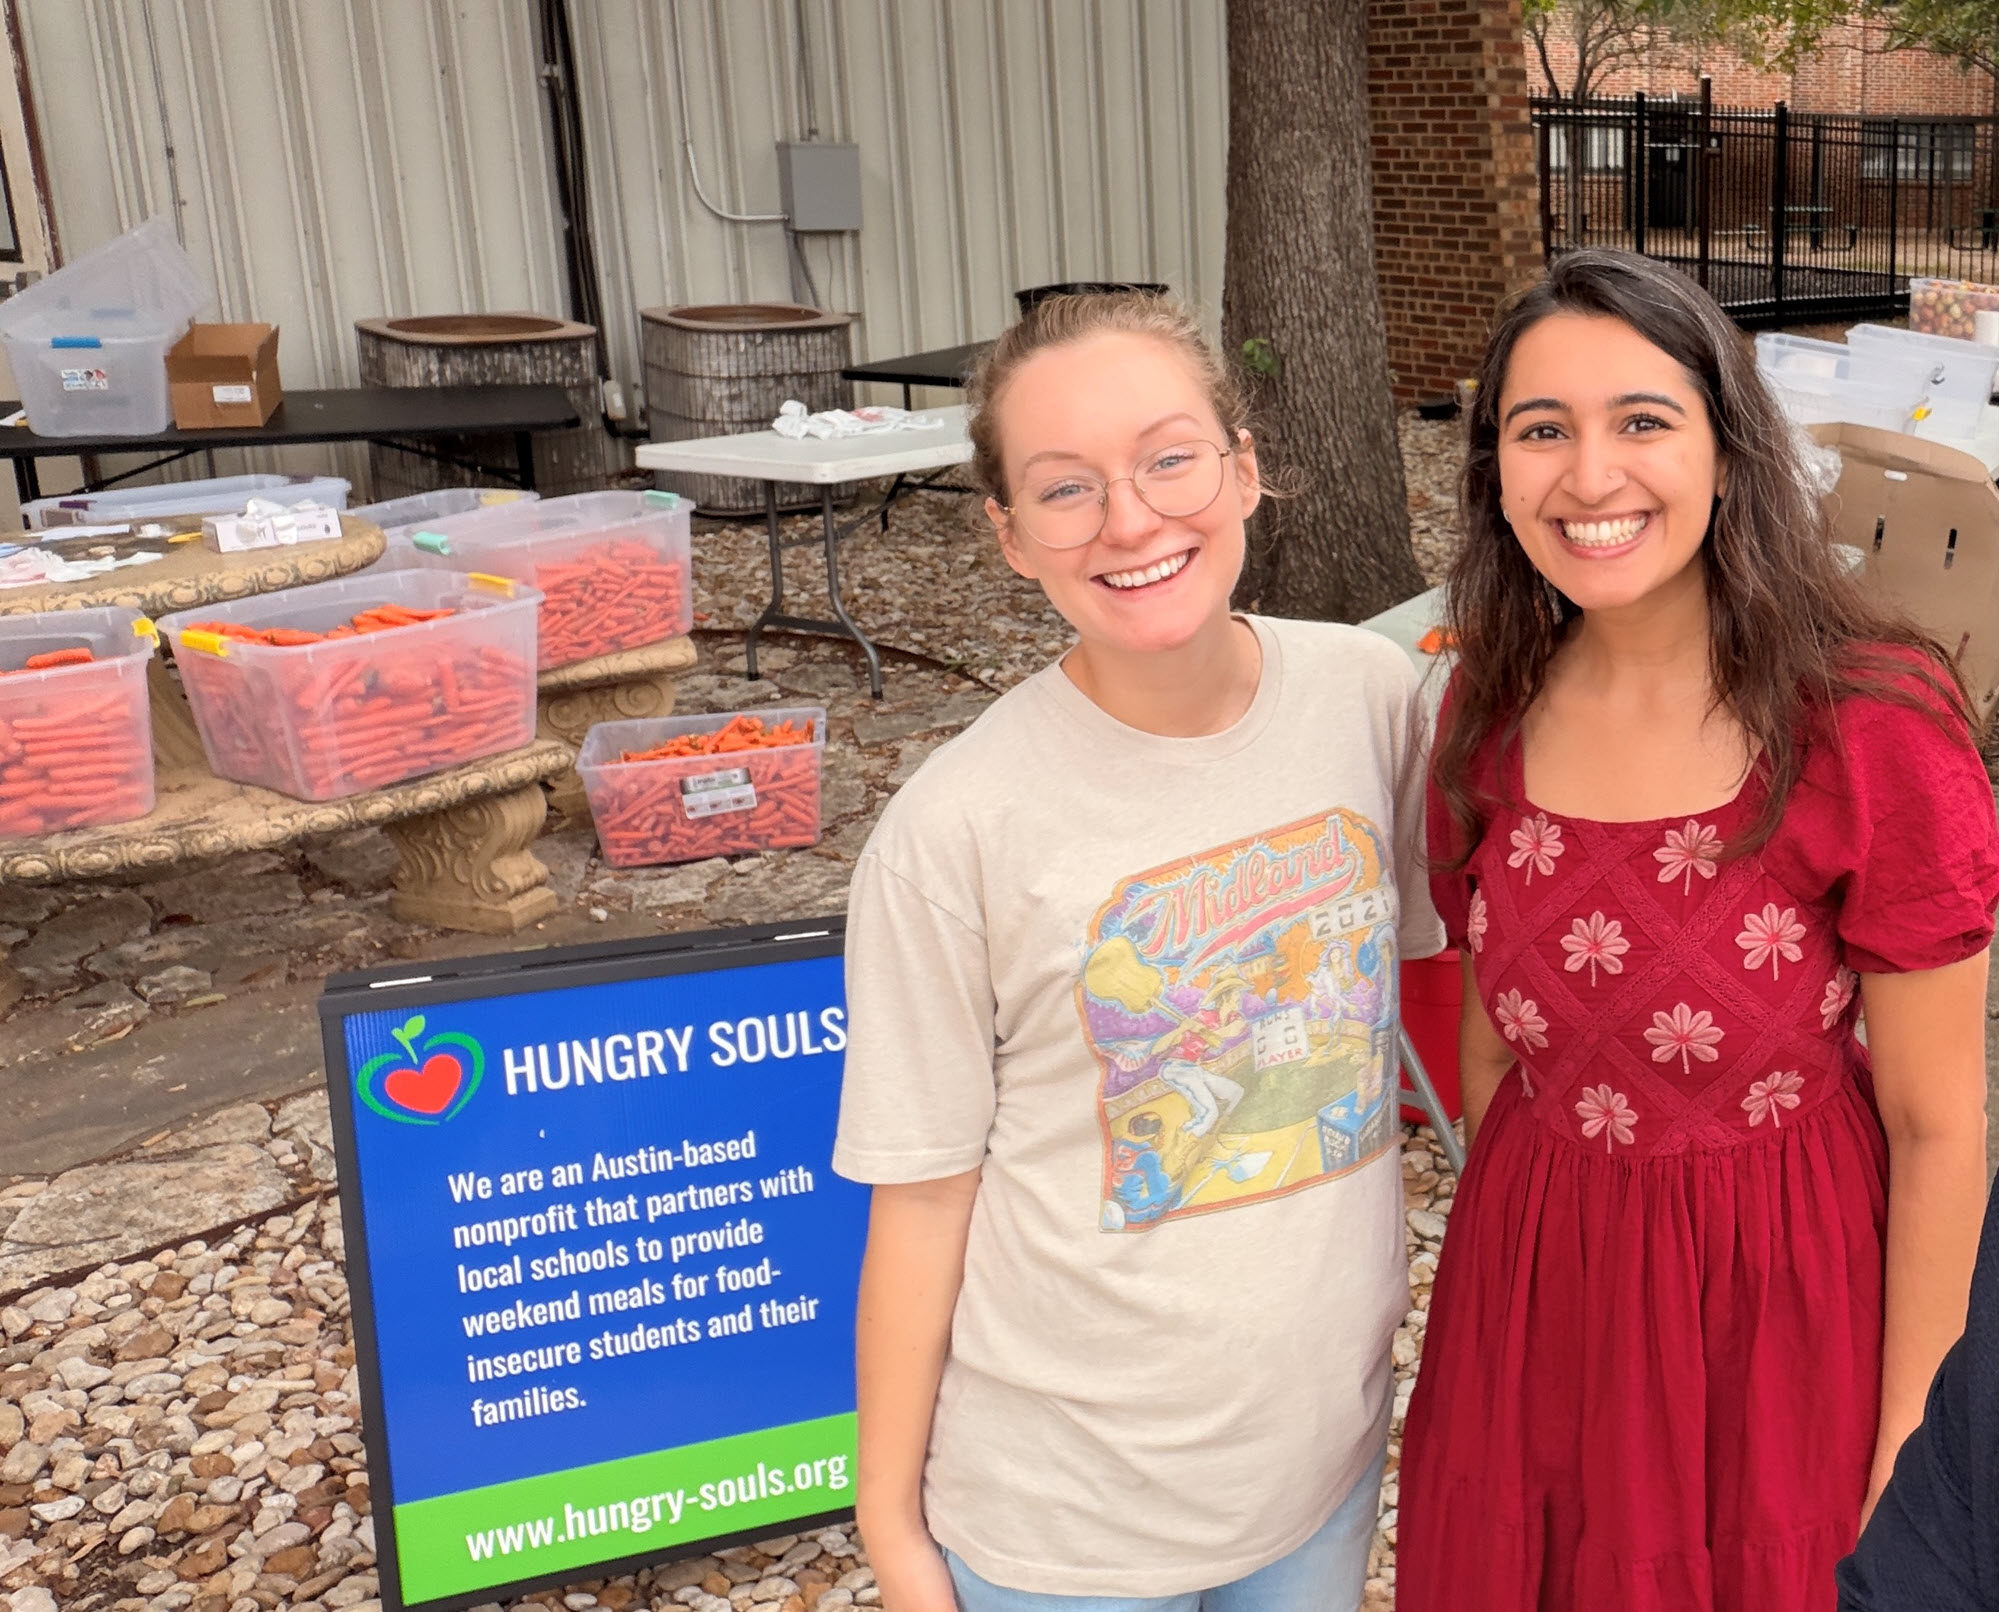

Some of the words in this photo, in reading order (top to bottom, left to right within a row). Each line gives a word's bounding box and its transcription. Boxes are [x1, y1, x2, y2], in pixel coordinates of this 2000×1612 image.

[1122, 817, 1352, 958] Midland
[1315, 889, 1390, 938] 2021
[503, 1025, 694, 1096] HUNGRY
[708, 1006, 848, 1068] SOULS
[447, 1171, 493, 1204] We
[500, 1168, 544, 1196] are
[551, 1162, 584, 1188] an
[591, 1130, 756, 1182] Austin-based
[453, 1203, 578, 1249] nonprofit
[584, 1194, 640, 1227] that
[646, 1181, 754, 1223] partners
[759, 1165, 814, 1199] with
[457, 1254, 523, 1294] local
[530, 1239, 630, 1281] schools
[635, 1236, 663, 1263] to
[670, 1217, 764, 1263] provide
[462, 1299, 582, 1338] weekend
[588, 1277, 666, 1316] meals
[671, 1269, 709, 1301] for
[715, 1257, 781, 1293] food-
[466, 1342, 582, 1383] insecure
[588, 1317, 702, 1360] students
[707, 1303, 753, 1338] and
[759, 1295, 819, 1328] their
[470, 1386, 587, 1427] families.
[465, 1454, 849, 1562] www.hungry-souls.org
